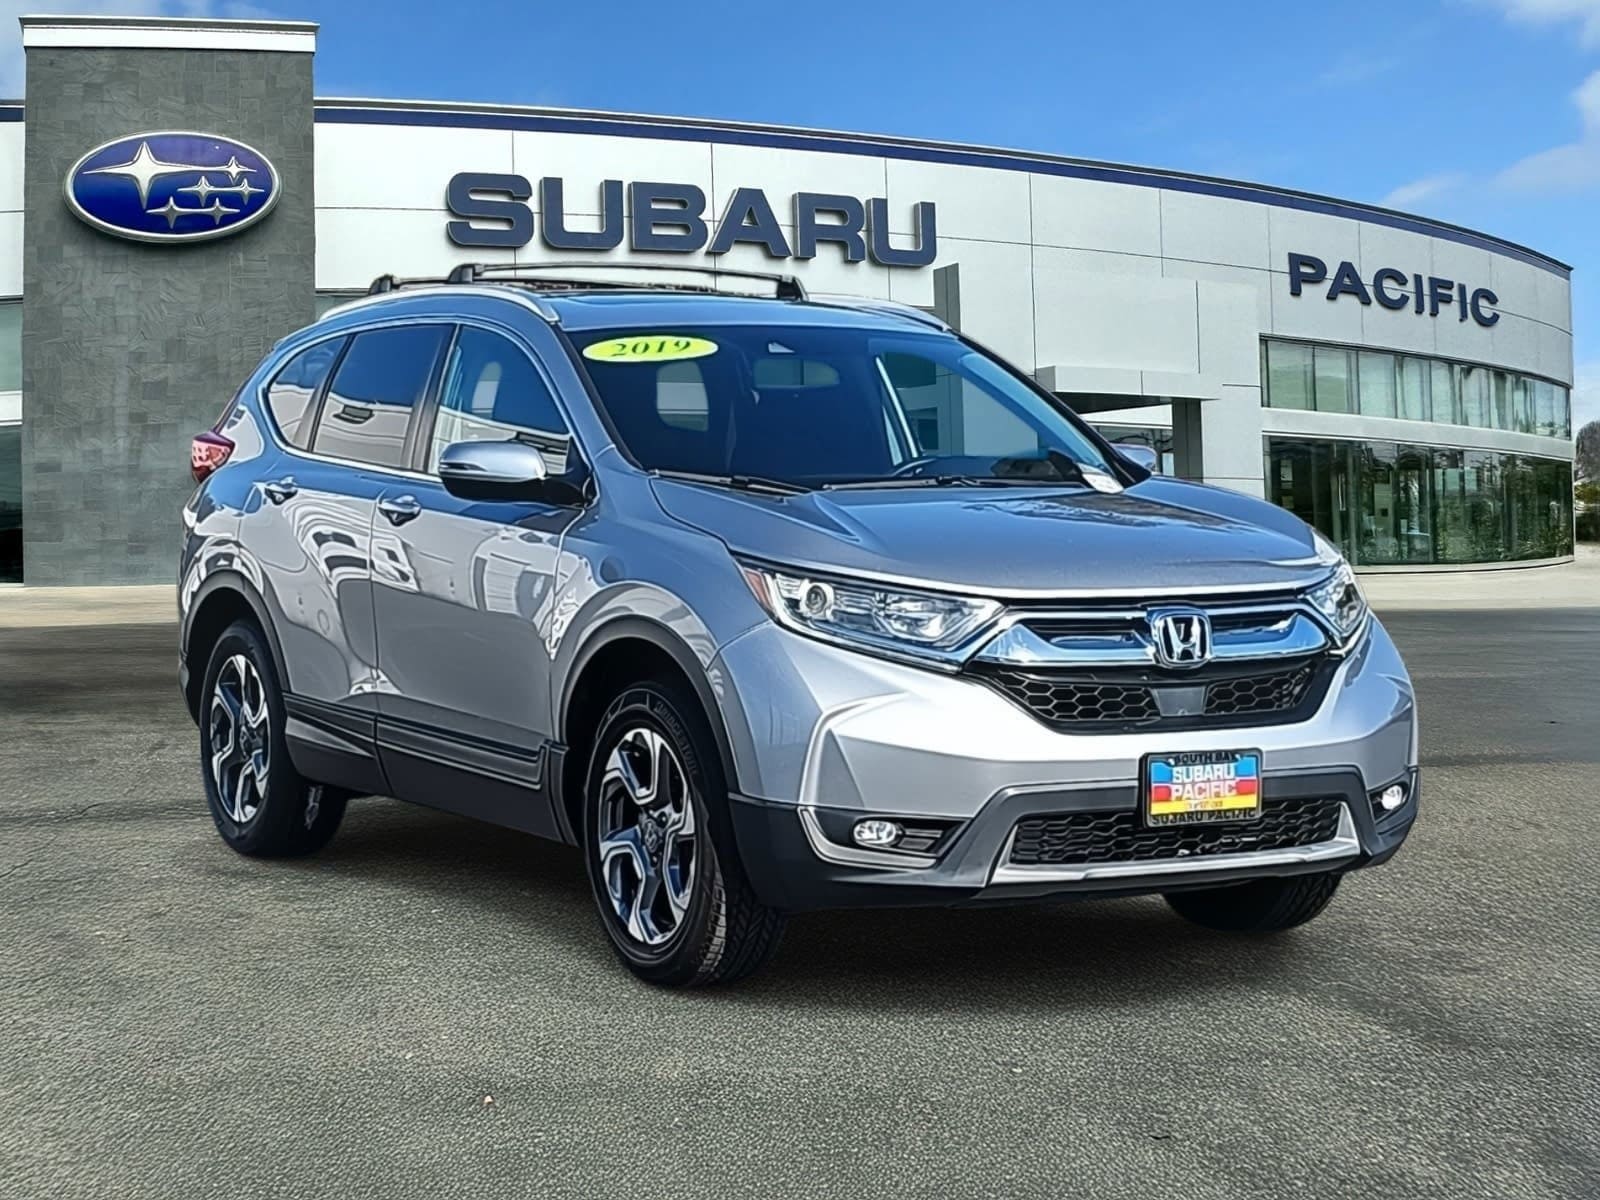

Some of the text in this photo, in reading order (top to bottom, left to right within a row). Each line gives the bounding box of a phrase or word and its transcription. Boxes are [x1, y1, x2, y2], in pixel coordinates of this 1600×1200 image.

[446, 172, 937, 267] SUBARU
[1288, 252, 1500, 327] PACIFIC
[611, 340, 691, 357] 2019
[1172, 763, 1235, 783] SUBARU
[1171, 779, 1237, 801] PACIFIC
